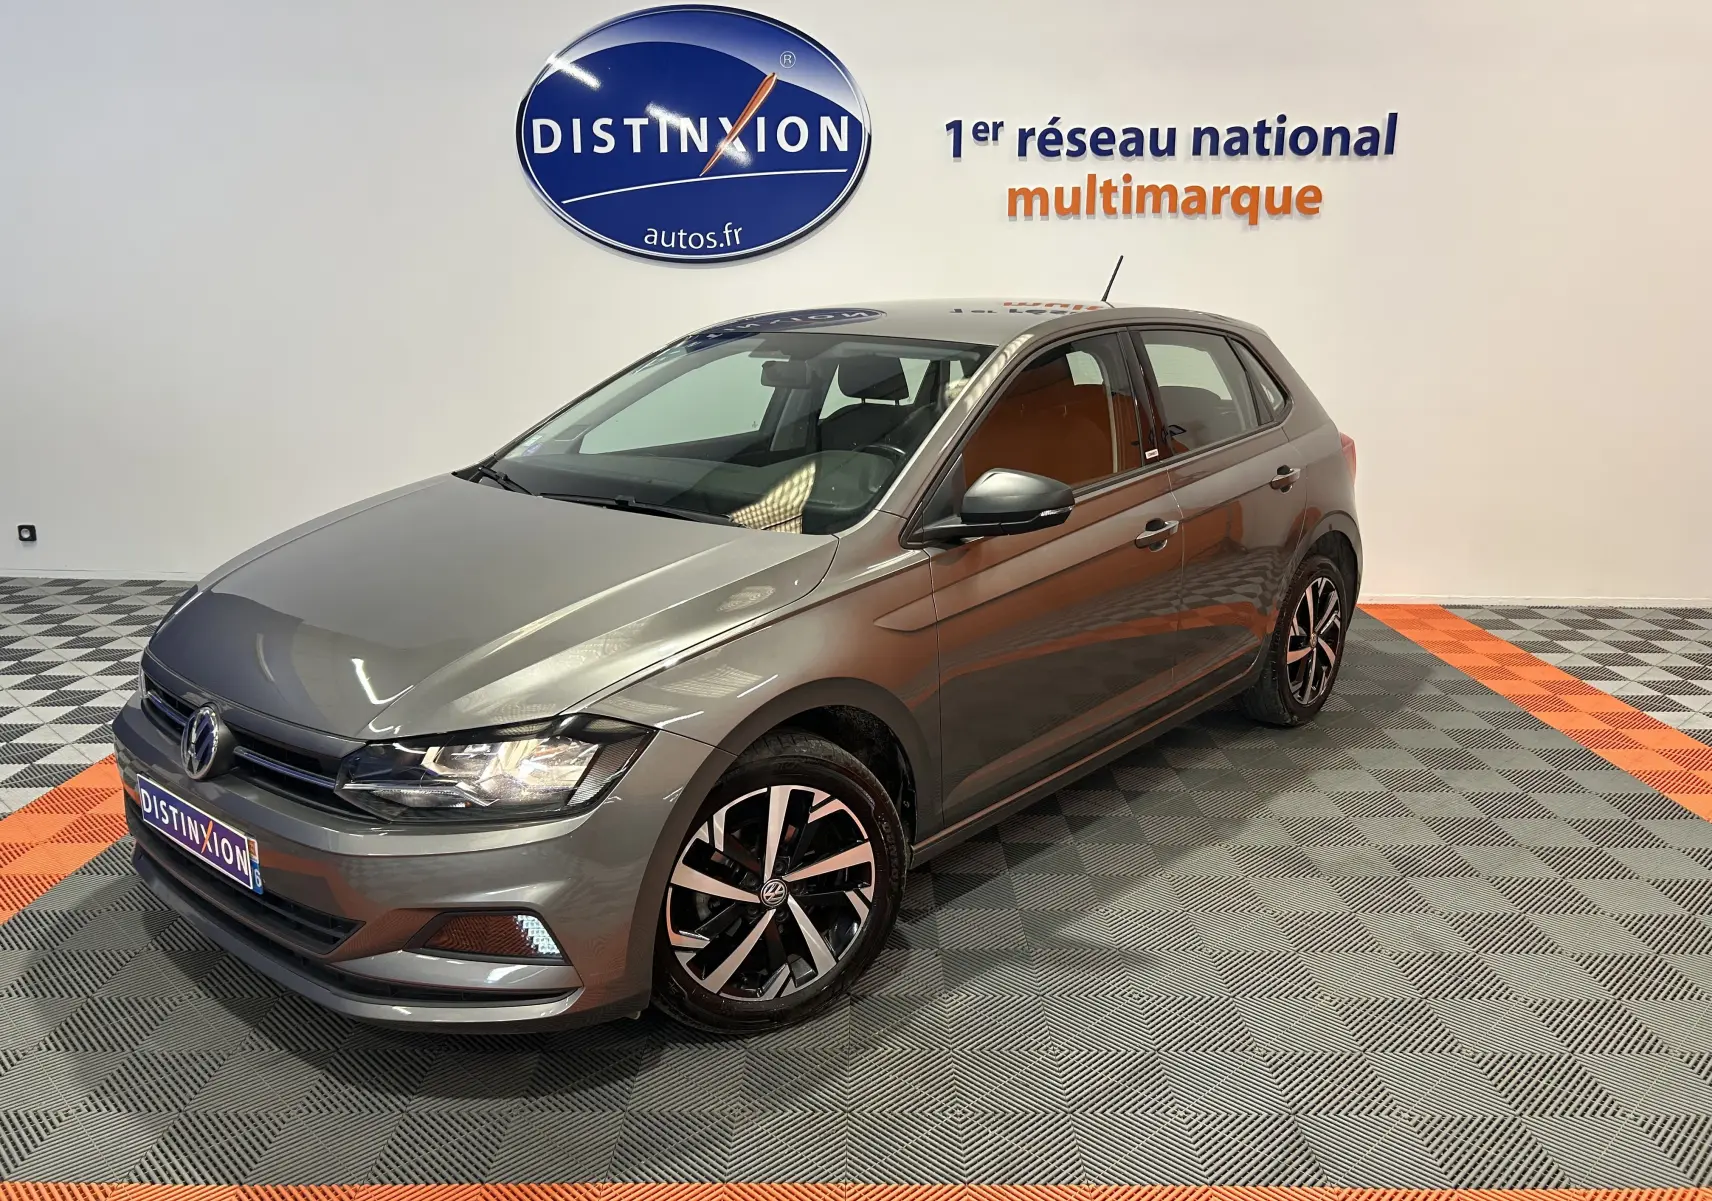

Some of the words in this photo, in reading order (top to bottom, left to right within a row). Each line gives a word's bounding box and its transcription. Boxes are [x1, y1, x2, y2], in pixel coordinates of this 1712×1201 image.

[532, 116, 849, 154] DISTINXION
[945, 117, 1004, 158] 1er
[1016, 116, 1177, 159] réseau
[1192, 112, 1399, 157] national
[1007, 173, 1323, 226] multimarque
[644, 222, 743, 250] autos.fr
[140, 787, 249, 877] DISTINXION
